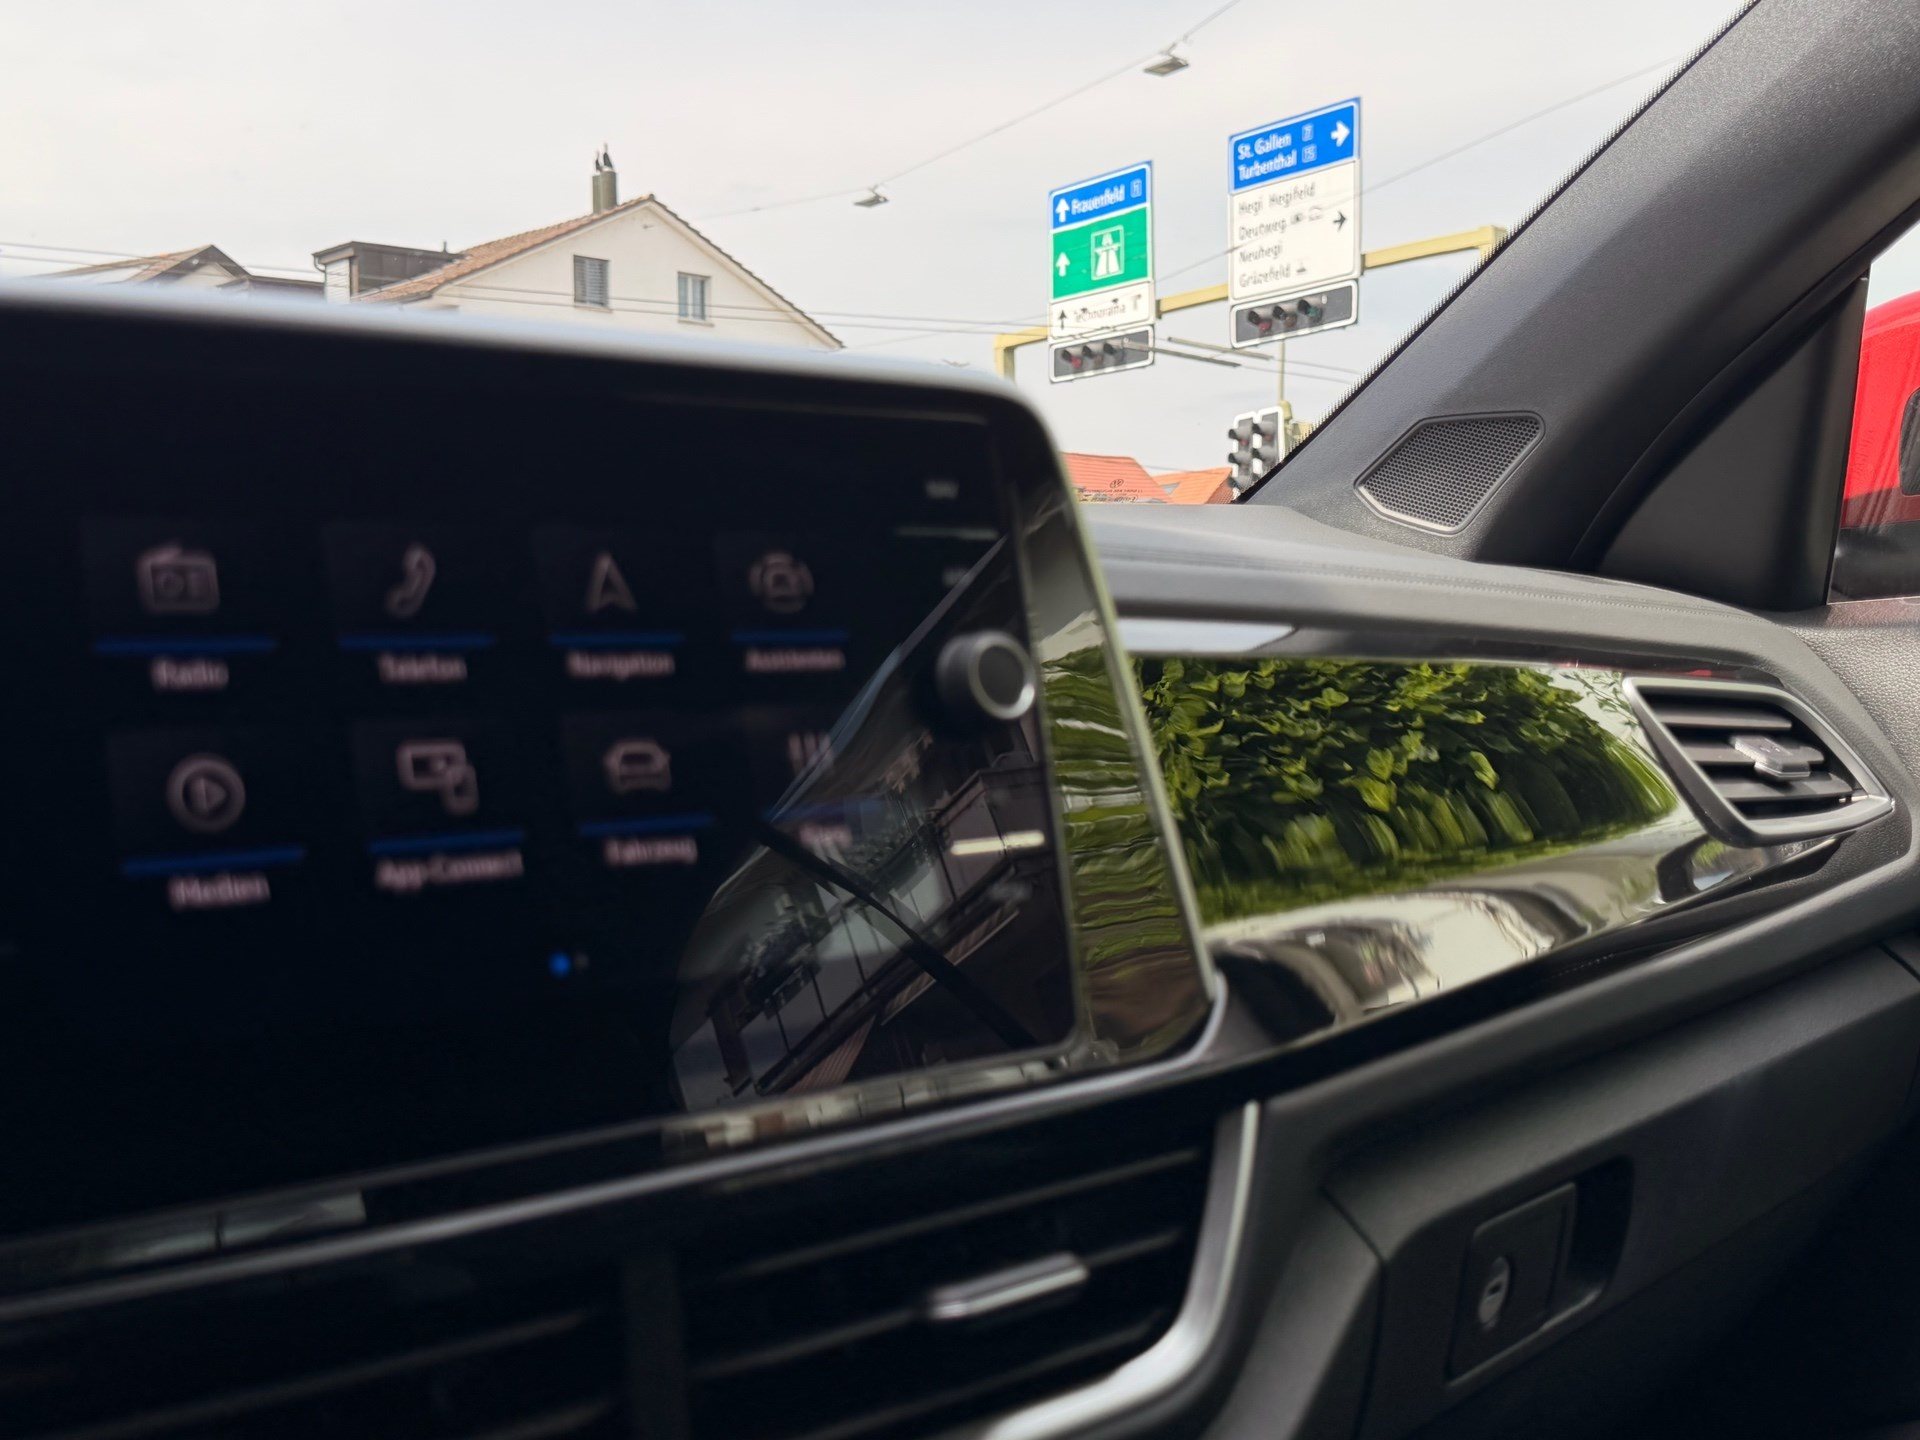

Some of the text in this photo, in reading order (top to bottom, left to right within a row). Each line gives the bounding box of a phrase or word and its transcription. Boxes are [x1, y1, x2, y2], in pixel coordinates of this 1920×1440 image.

[1238, 143, 1253, 160] St.
[1254, 132, 1292, 155] Gallen
[1238, 149, 1297, 180] Turbenthal
[1071, 184, 1125, 215] Frauenfeld
[151, 657, 229, 689] Radio
[377, 653, 467, 682] Telefon
[567, 650, 675, 681] Navigation
